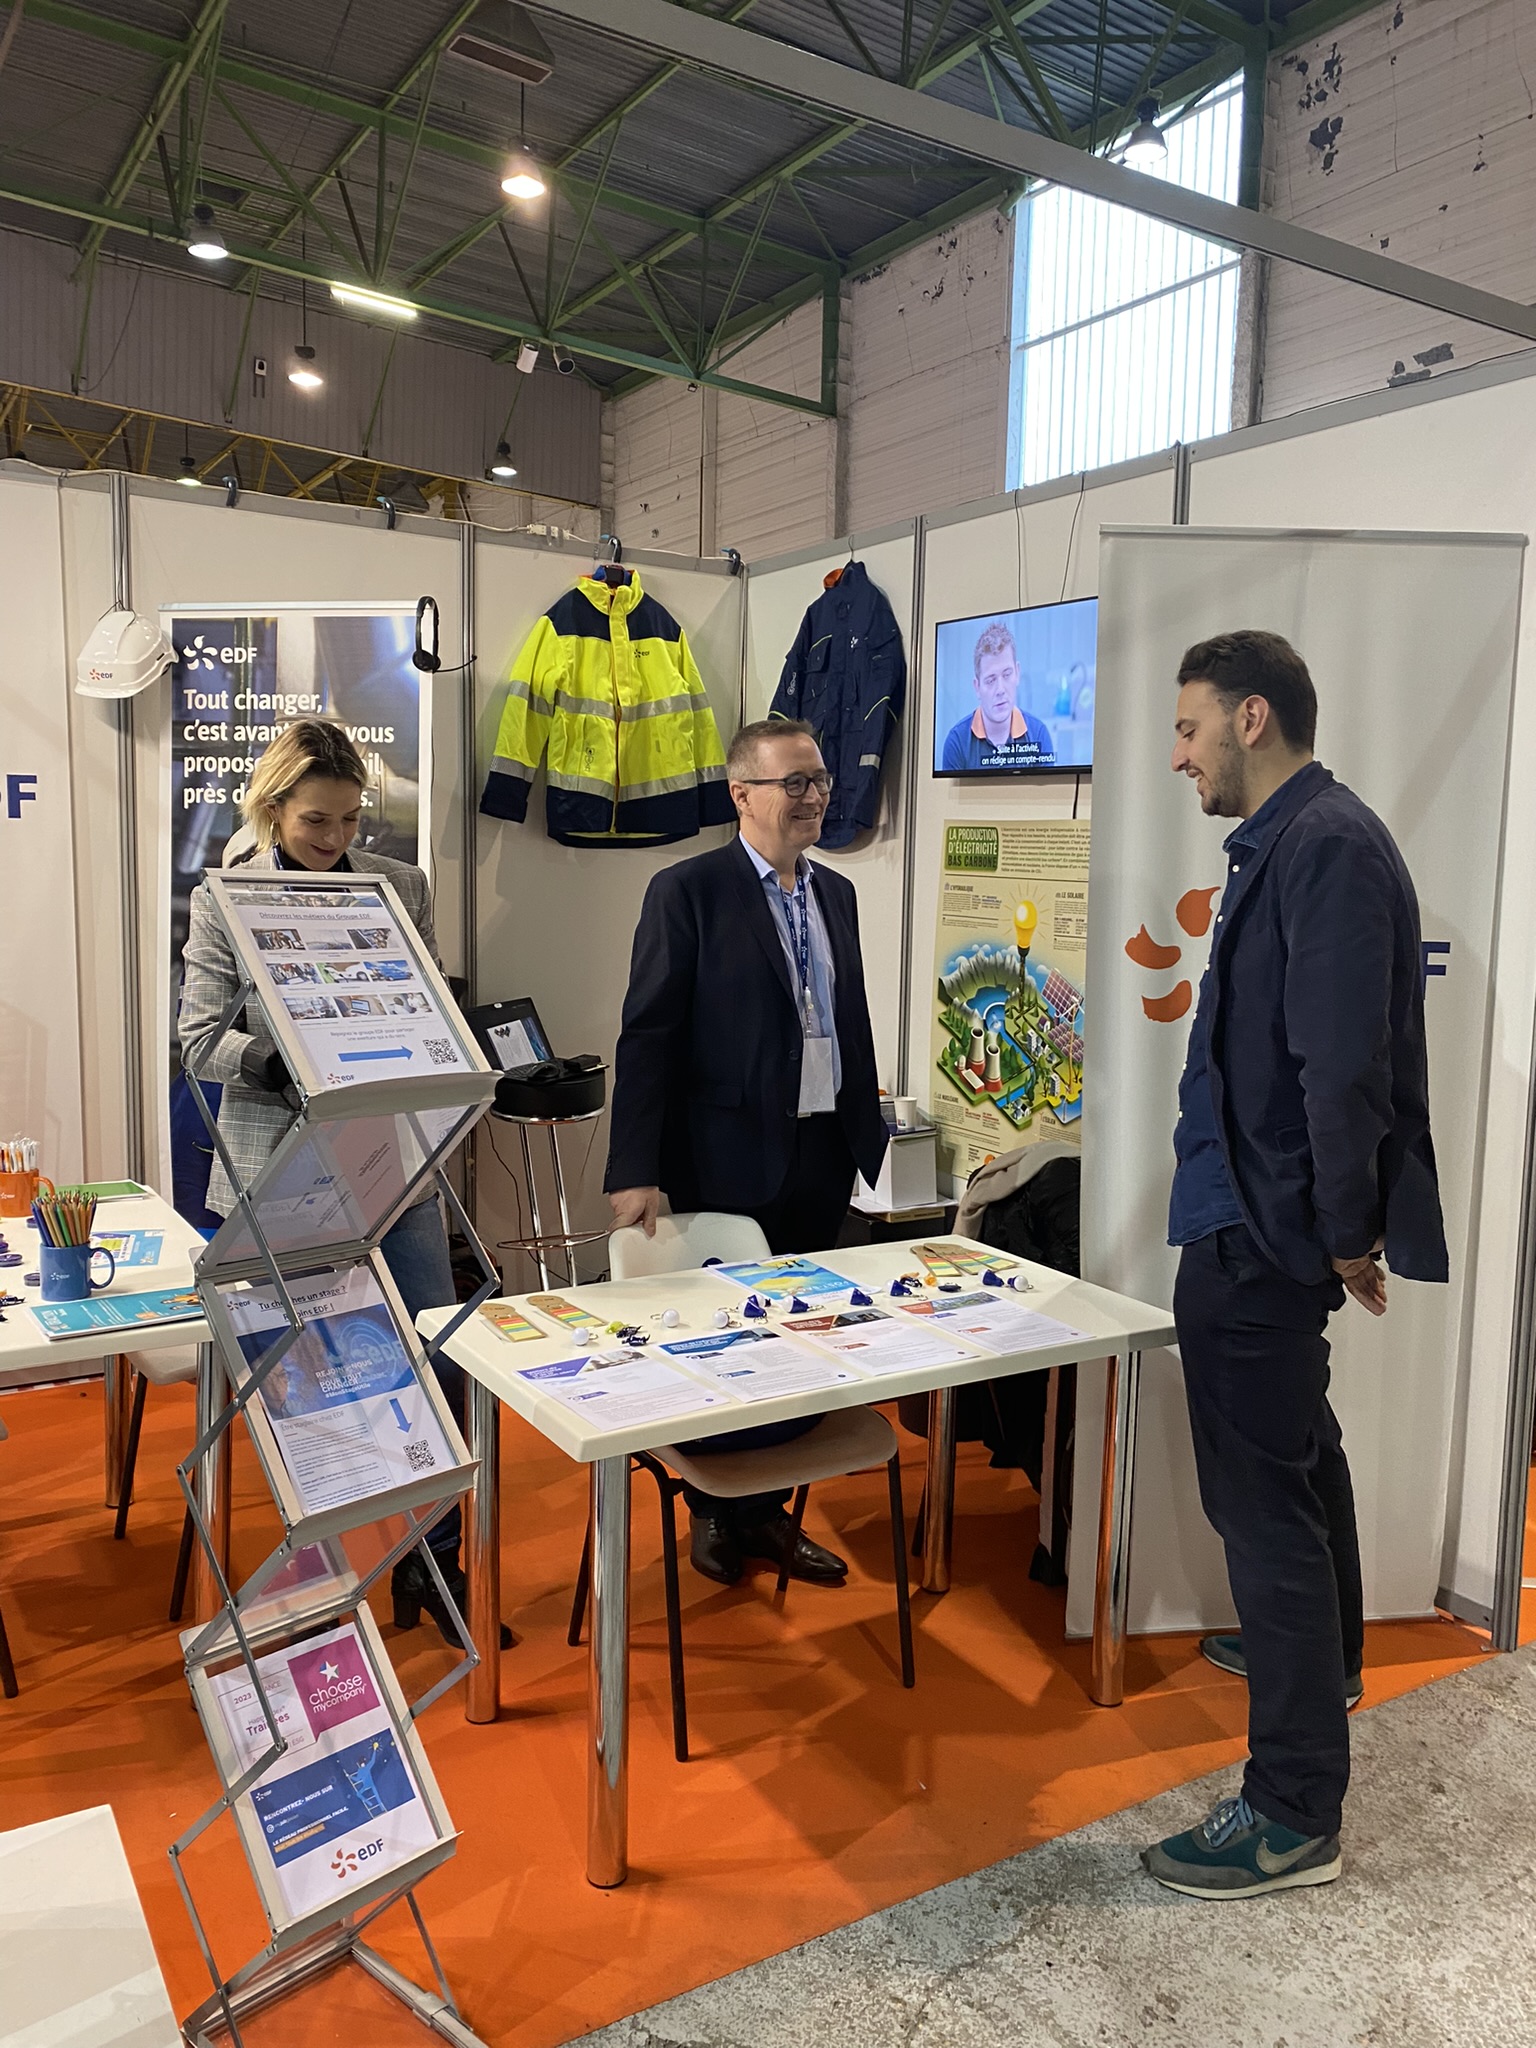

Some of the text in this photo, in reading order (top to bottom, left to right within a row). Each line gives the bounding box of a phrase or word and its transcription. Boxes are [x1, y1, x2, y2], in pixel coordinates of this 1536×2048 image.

[183, 688, 323, 714] Tout changer,
[183, 720, 228, 741] c'est
[344, 726, 395, 743] vous
[1015, 754, 1056, 765] compte-rendu
[183, 785, 227, 809] près
[949, 828, 997, 841] LA PRODUCTION
[948, 840, 997, 855] D'ÉLECTRICITÉ
[948, 855, 997, 868] BAS CARBONE
[258, 1302, 270, 1311] Tu
[307, 1293, 318, 1301] un
[319, 1288, 340, 1298] stage
[314, 1305, 329, 1314] EDF
[322, 1379, 358, 1393] CHANGER
[309, 1675, 363, 1705] choose
[234, 1693, 252, 1704] 2023
[305, 1790, 321, 1802] NOUS
[321, 1784, 334, 1795] SUR
